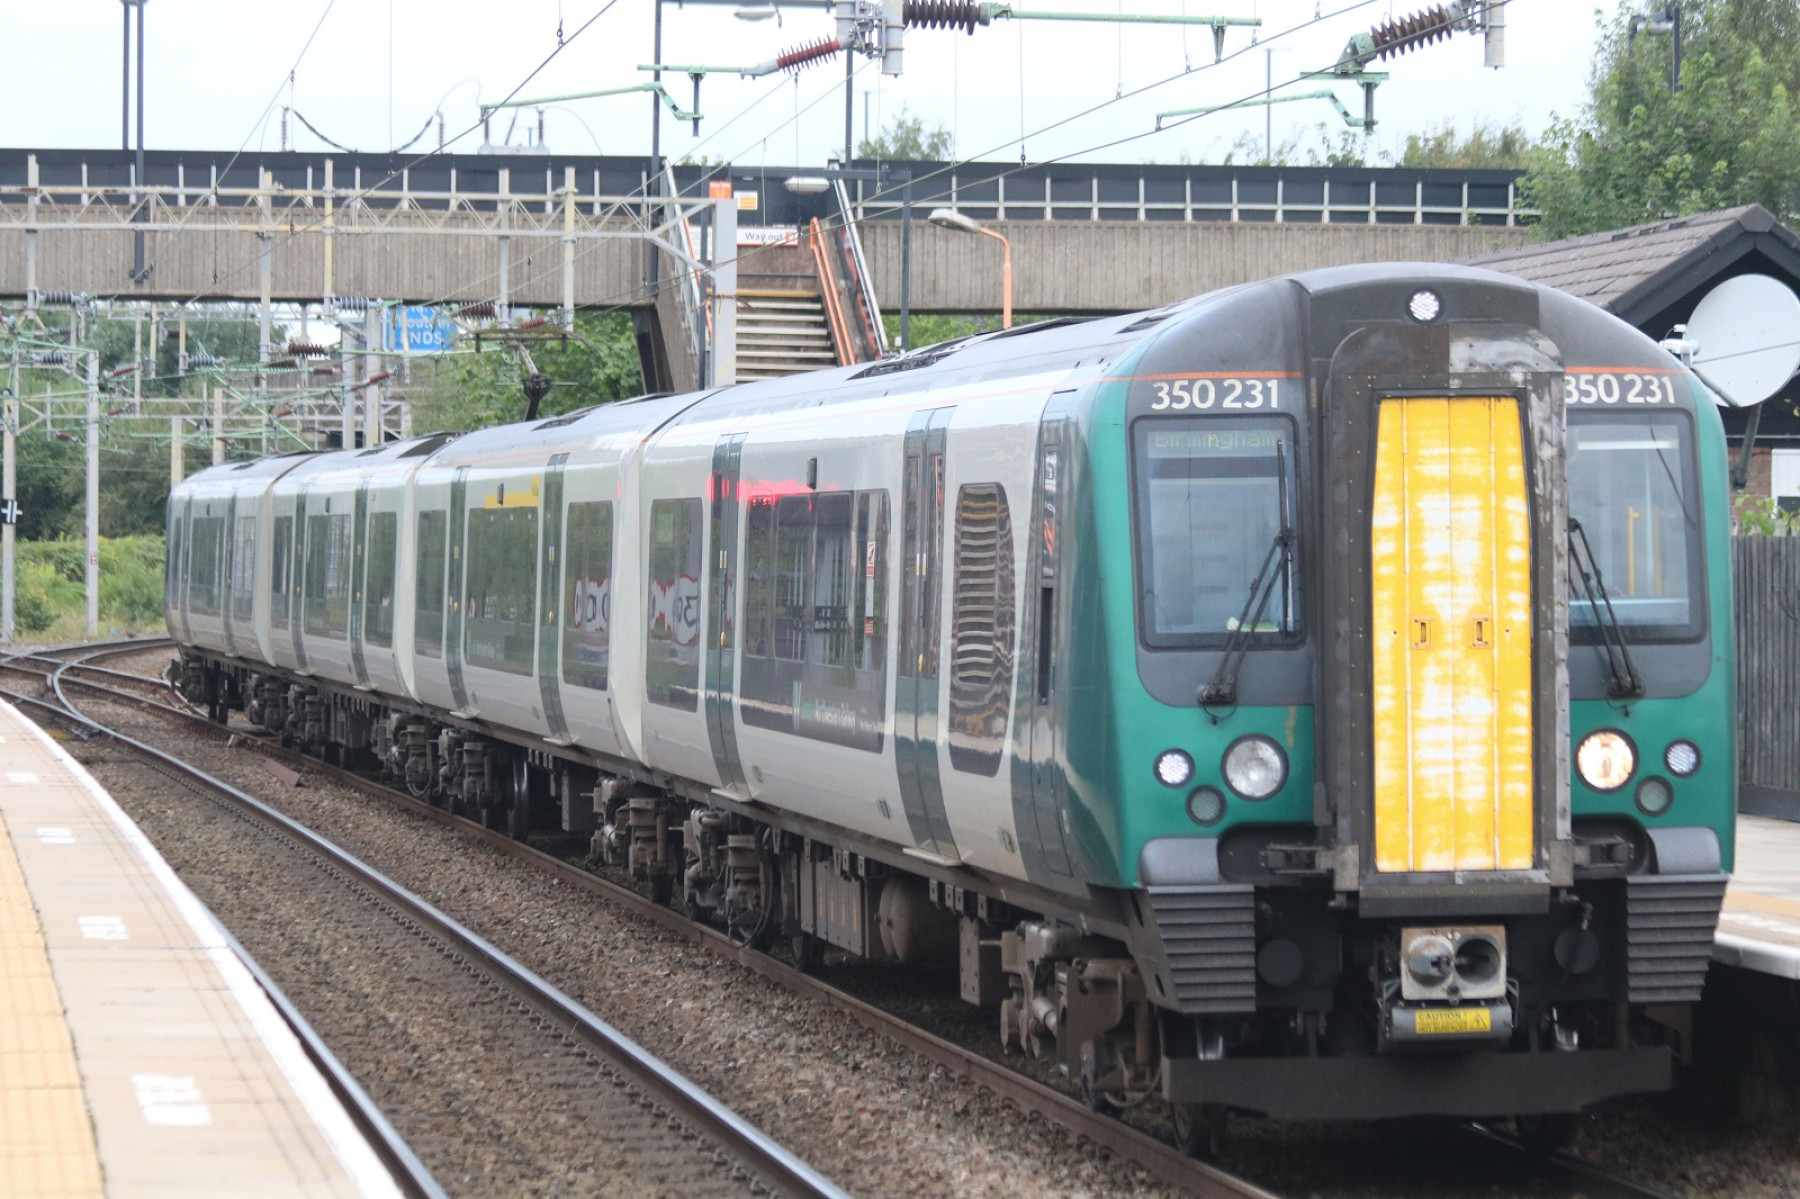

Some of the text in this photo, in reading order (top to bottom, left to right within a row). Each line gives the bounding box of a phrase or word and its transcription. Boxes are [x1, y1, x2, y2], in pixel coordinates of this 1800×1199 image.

[745, 232, 783, 243] Way out
[1151, 379, 1278, 410] 350 231
[1565, 374, 1675, 404] 350 231
[1156, 432, 1277, 450] Birmingham
[1418, 1011, 1461, 1020] CAUTION
